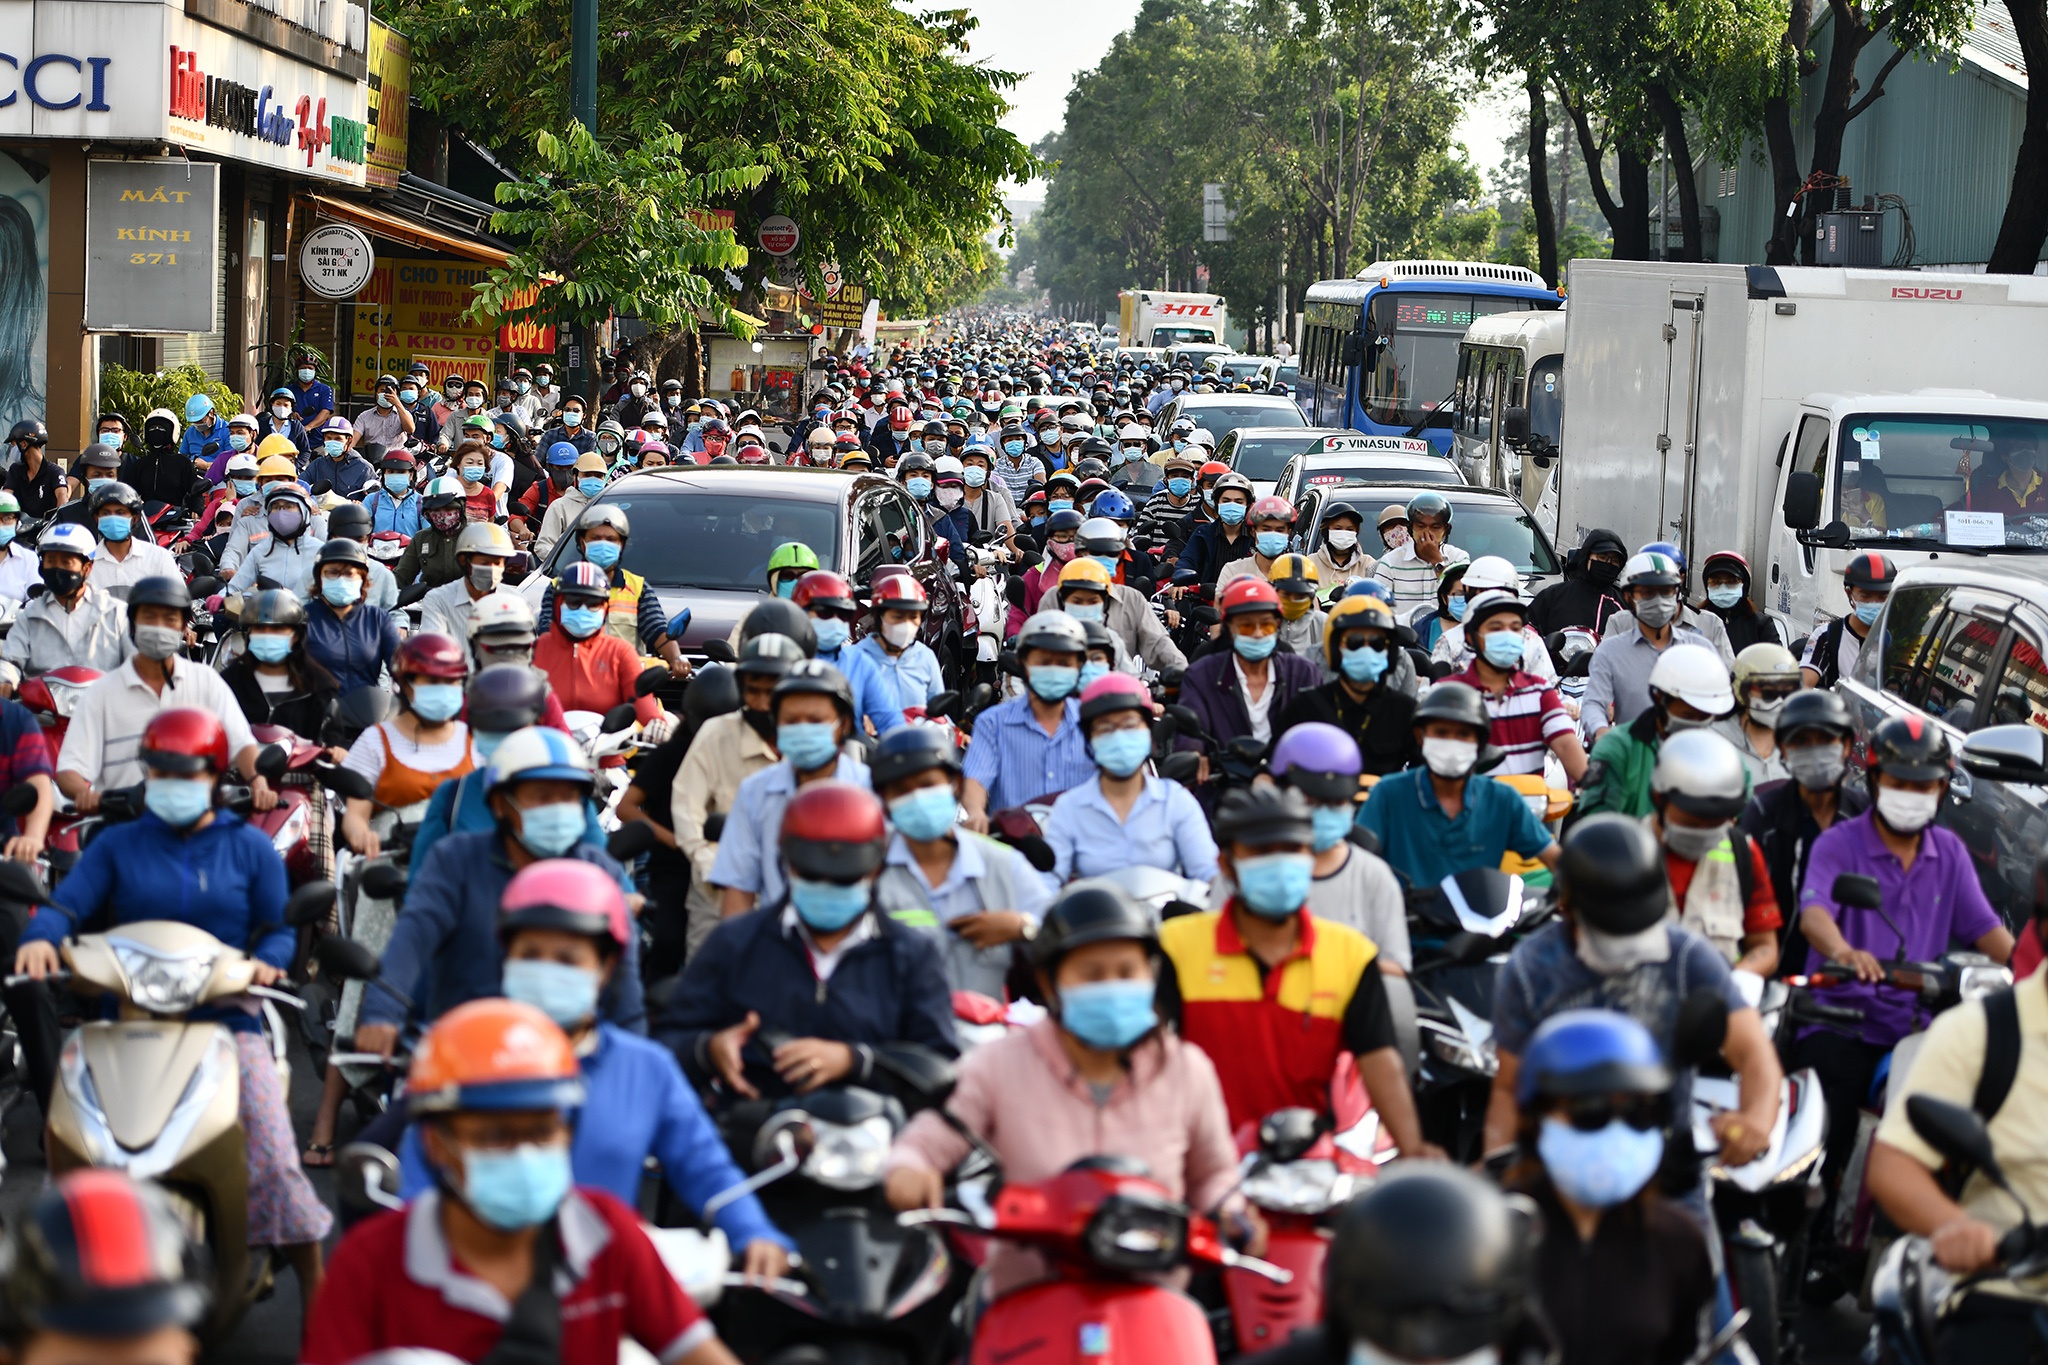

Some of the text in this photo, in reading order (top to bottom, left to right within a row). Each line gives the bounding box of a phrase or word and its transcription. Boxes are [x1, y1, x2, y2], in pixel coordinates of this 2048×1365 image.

[120, 186, 191, 203] MẮT
[117, 226, 191, 242] KÍNH
[130, 253, 177, 265] 371
[322, 269, 348, 277] 371 NK
[400, 266, 439, 284] CHO
[842, 285, 863, 303] CUA
[1892, 287, 1962, 300] ISUZU
[1163, 303, 1214, 316] HTL
[508, 321, 547, 349] COPY
[407, 335, 455, 350] KHO
[462, 335, 492, 355] TỘ
[1349, 439, 1426, 451] VINASUN TAXI
